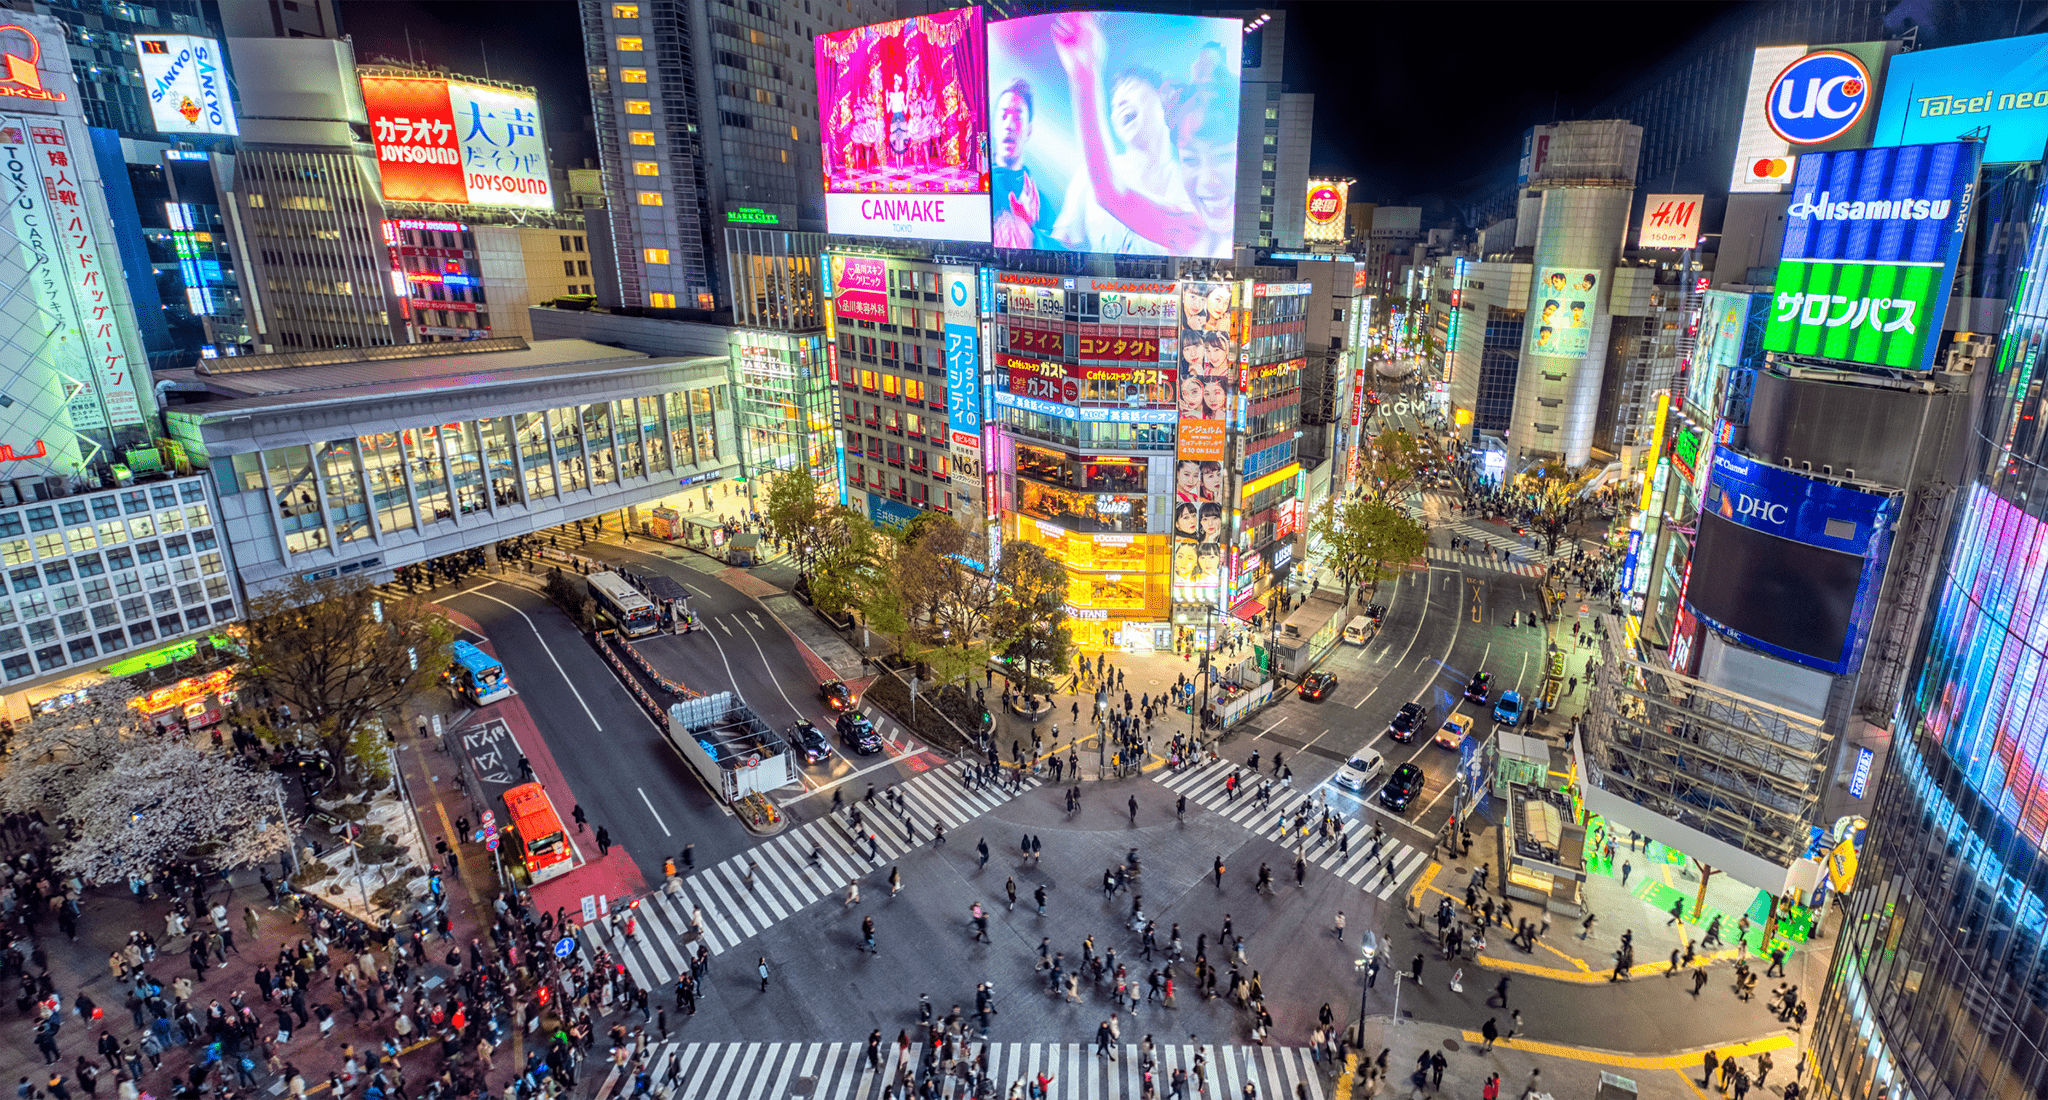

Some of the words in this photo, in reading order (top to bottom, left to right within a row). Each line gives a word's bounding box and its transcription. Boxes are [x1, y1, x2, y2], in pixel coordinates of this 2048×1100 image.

[152, 49, 191, 103] SANKYO
[195, 46, 222, 126] SANKYO
[1778, 75, 1861, 120] UC
[1917, 90, 1993, 118] Taisei
[375, 116, 452, 145] カラオケ
[458, 101, 536, 147] 大声
[380, 145, 459, 165] JOYSOUND
[469, 173, 547, 195] JOYSOUND
[3, 146, 33, 210] TOKYU
[24, 214, 49, 264] CARD
[861, 199, 945, 222] CANMAKE
[1310, 198, 1337, 212] 楽園
[1650, 201, 1696, 228] H&M
[1788, 191, 1951, 222] Hisamitsu
[1954, 183, 1974, 234] サロンパス
[728, 211, 755, 220] MARK
[755, 213, 778, 221] CITY
[892, 224, 912, 233] TOKYO
[1652, 233, 1676, 241] 150m
[47, 150, 123, 385] 婦人靴・ハンドバッグバーゲン
[854, 263, 884, 276] 品川スキン
[855, 275, 881, 287] クリニック
[842, 299, 886, 317] 品川美容外科
[997, 293, 1007, 303] 9F
[1127, 299, 1176, 317] しゃぶ葉
[1776, 292, 1916, 336] サロンパス
[1010, 330, 1062, 350] プライス
[1360, 314, 1369, 347] CAMERA
[1080, 340, 1156, 356] コンタクト
[949, 333, 964, 424] アイシティ
[964, 336, 976, 425] コンタクトの
[998, 373, 1010, 386] 7F
[1041, 361, 1068, 379] ガスト
[1133, 369, 1168, 384] ガスト
[1027, 377, 1060, 398] ガスト
[1016, 398, 1063, 415] 英会話イーオン
[1111, 410, 1176, 423] 英会話イーオン
[1181, 425, 1222, 434] アンジュルム
[952, 454, 980, 477] No.1
[1736, 493, 1788, 525] DHC
[1275, 544, 1292, 565] LUSH
